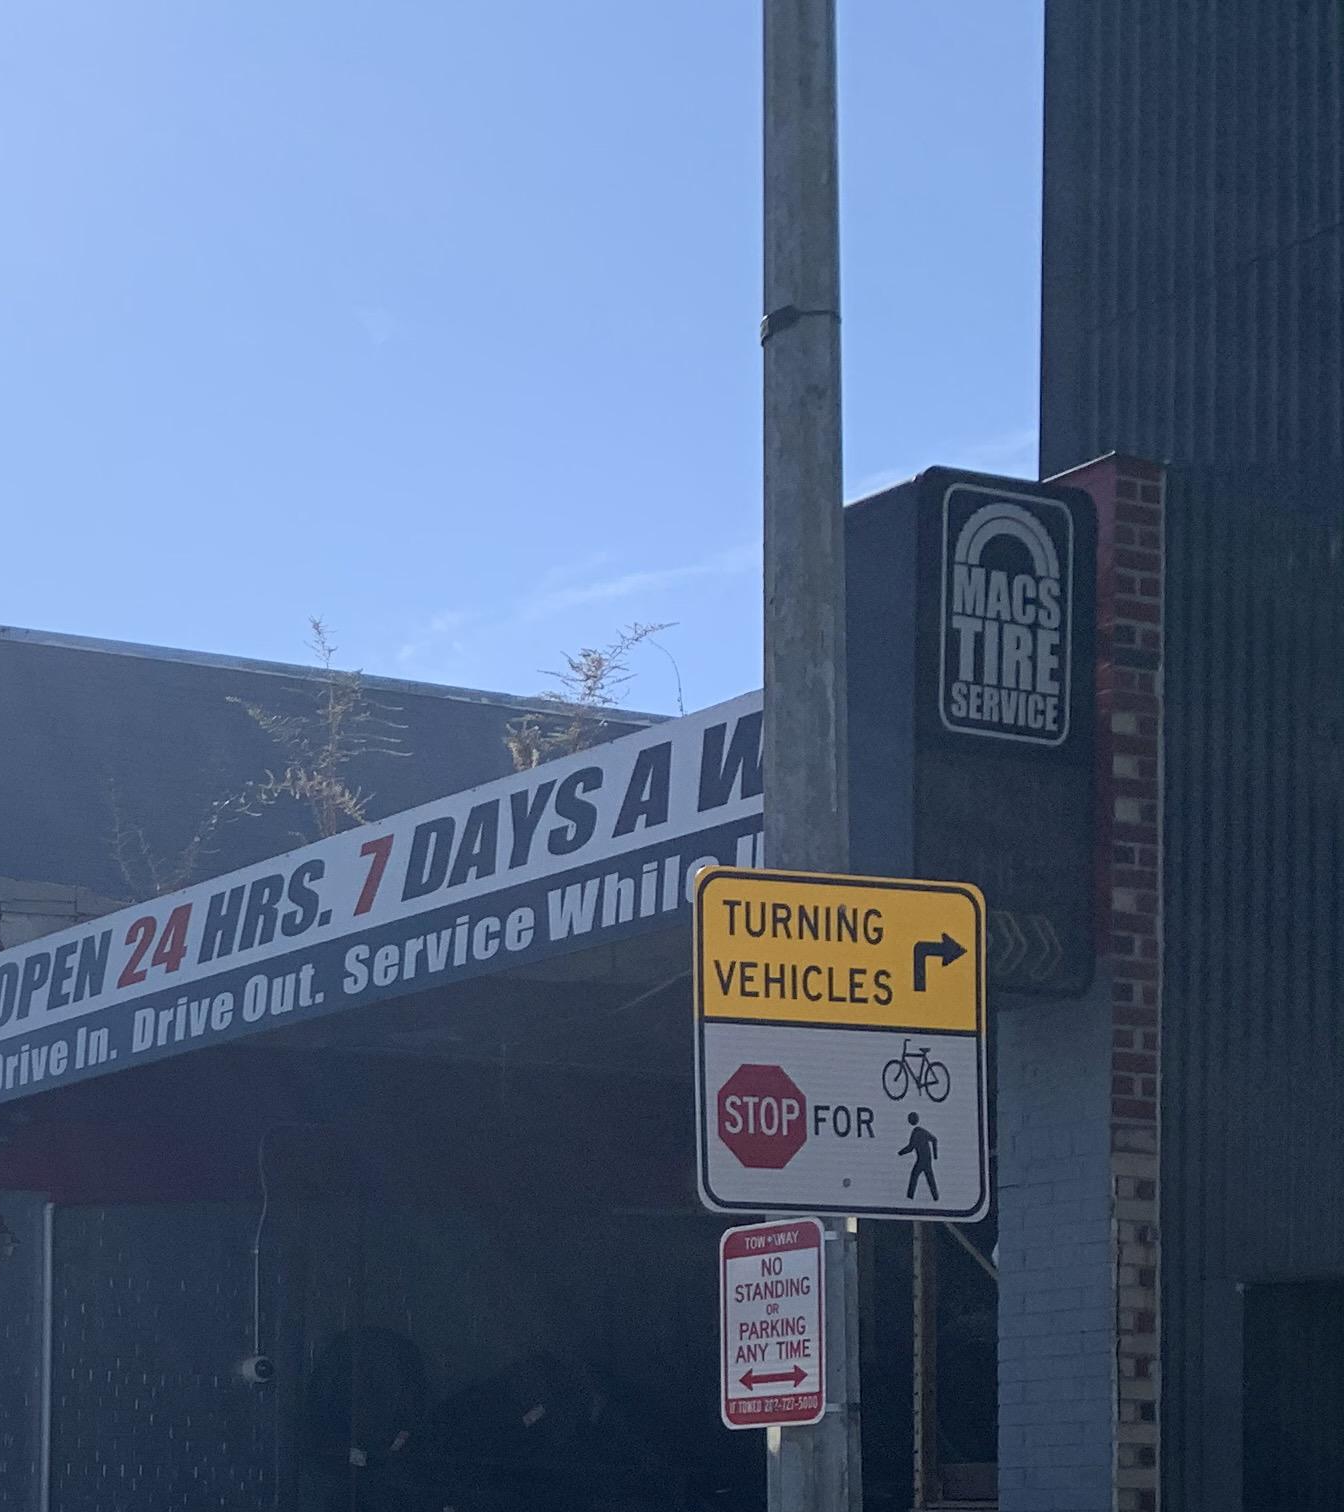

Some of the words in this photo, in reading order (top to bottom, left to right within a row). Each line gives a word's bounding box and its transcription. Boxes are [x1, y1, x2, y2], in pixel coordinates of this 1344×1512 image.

[952, 563, 1061, 629] MACS
[952, 614, 1060, 695] TIRE
[951, 681, 1059, 731] SERVICE
[116, 902, 194, 990] 24
[197, 858, 332, 963] HRS.
[353, 834, 395, 917] 7
[402, 765, 603, 902] DAYS
[612, 740, 671, 839] A
[722, 899, 884, 946] TURNING
[74, 1025, 118, 1071] In.
[131, 990, 234, 1056] Drive
[242, 968, 325, 1019] Out.
[343, 906, 534, 994] Service
[713, 959, 892, 1006] VEHICLES
[724, 1095, 800, 1137] STOP
[813, 1104, 876, 1138] FOR
[745, 1236, 766, 1250] TOW
[761, 1256, 783, 1277] NO
[735, 1276, 811, 1302] STANDING
[766, 1303, 780, 1316] OR
[739, 1316, 806, 1342] PARKING
[736, 1342, 769, 1363] ANY
[776, 1339, 811, 1360] TIME
[739, 1399, 763, 1414] TOWED
